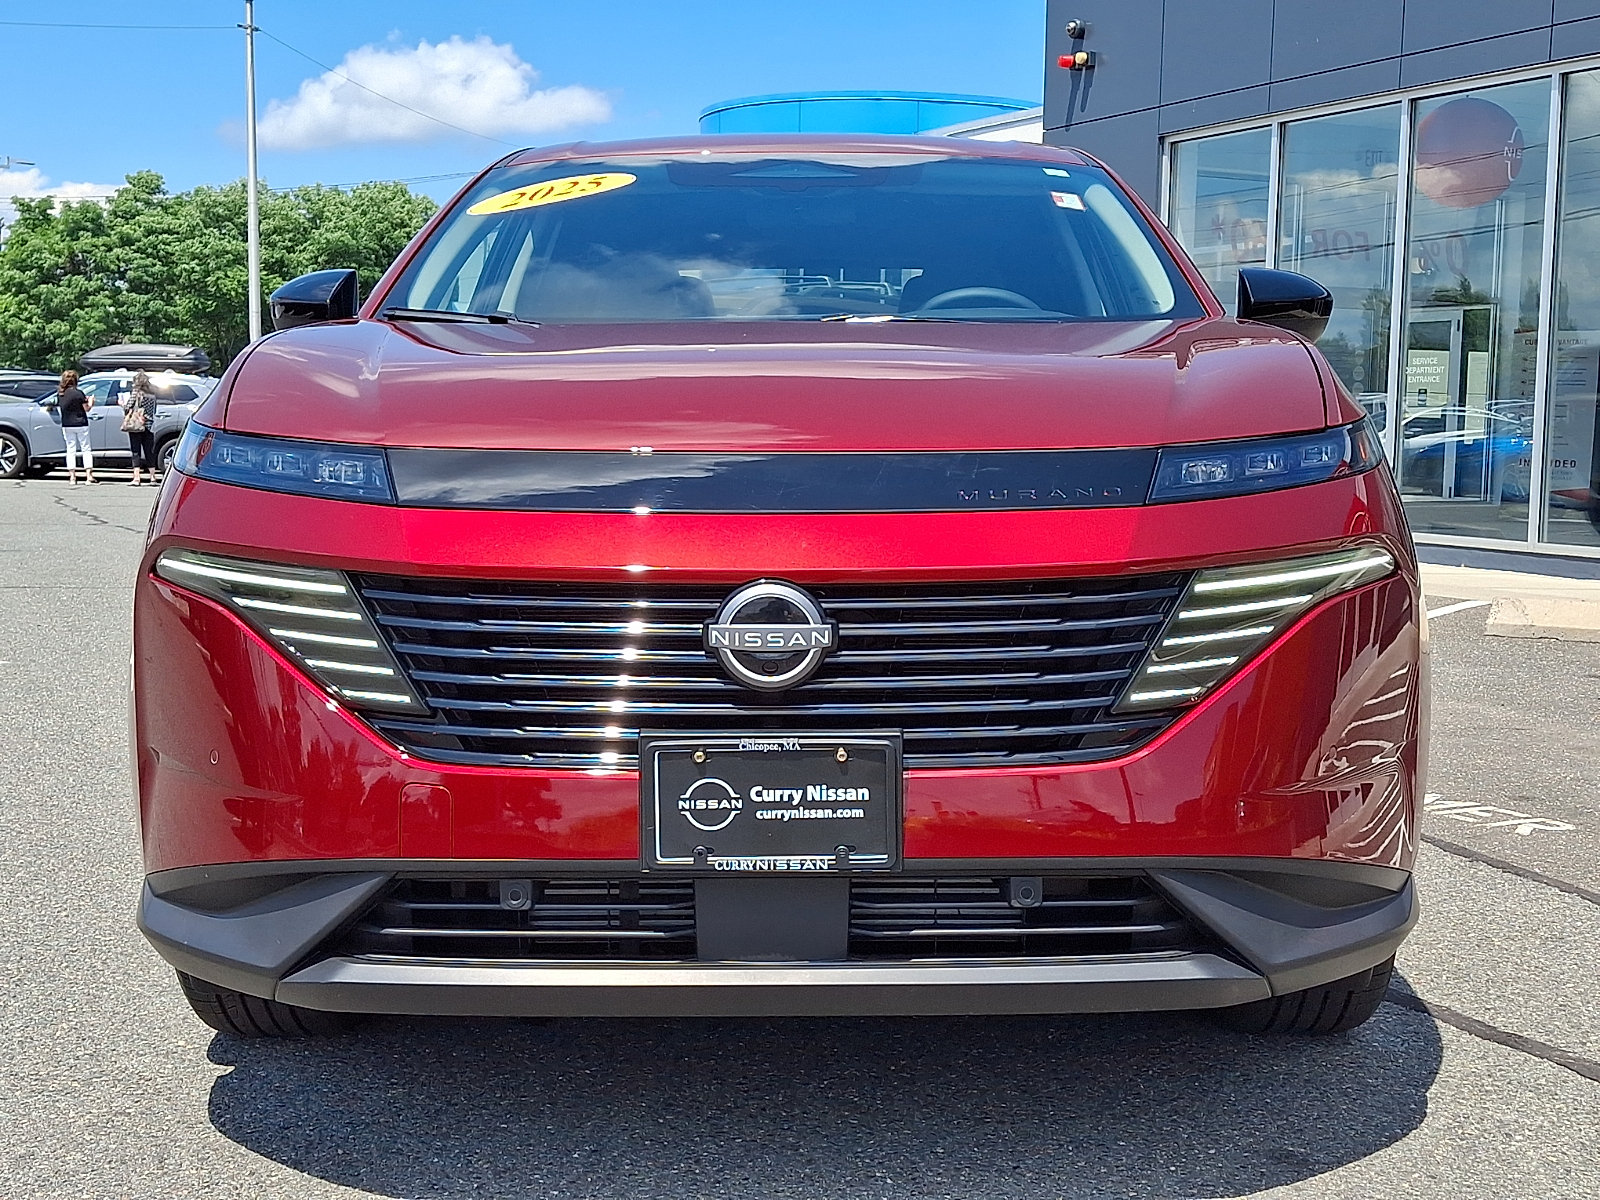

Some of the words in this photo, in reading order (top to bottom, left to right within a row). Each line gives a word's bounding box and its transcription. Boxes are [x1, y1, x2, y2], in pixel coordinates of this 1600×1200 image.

[500, 176, 608, 209] 2025
[1412, 357, 1438, 365] SERVICE
[1405, 366, 1445, 375] DEPARTMENT
[958, 487, 1122, 500] MURANO
[711, 629, 830, 648] NISSAN
[782, 738, 801, 751] MA
[749, 785, 803, 806] Curry
[806, 784, 870, 802] Nissan
[678, 798, 743, 810] NISSAN
[755, 806, 865, 822] currynissan.com
